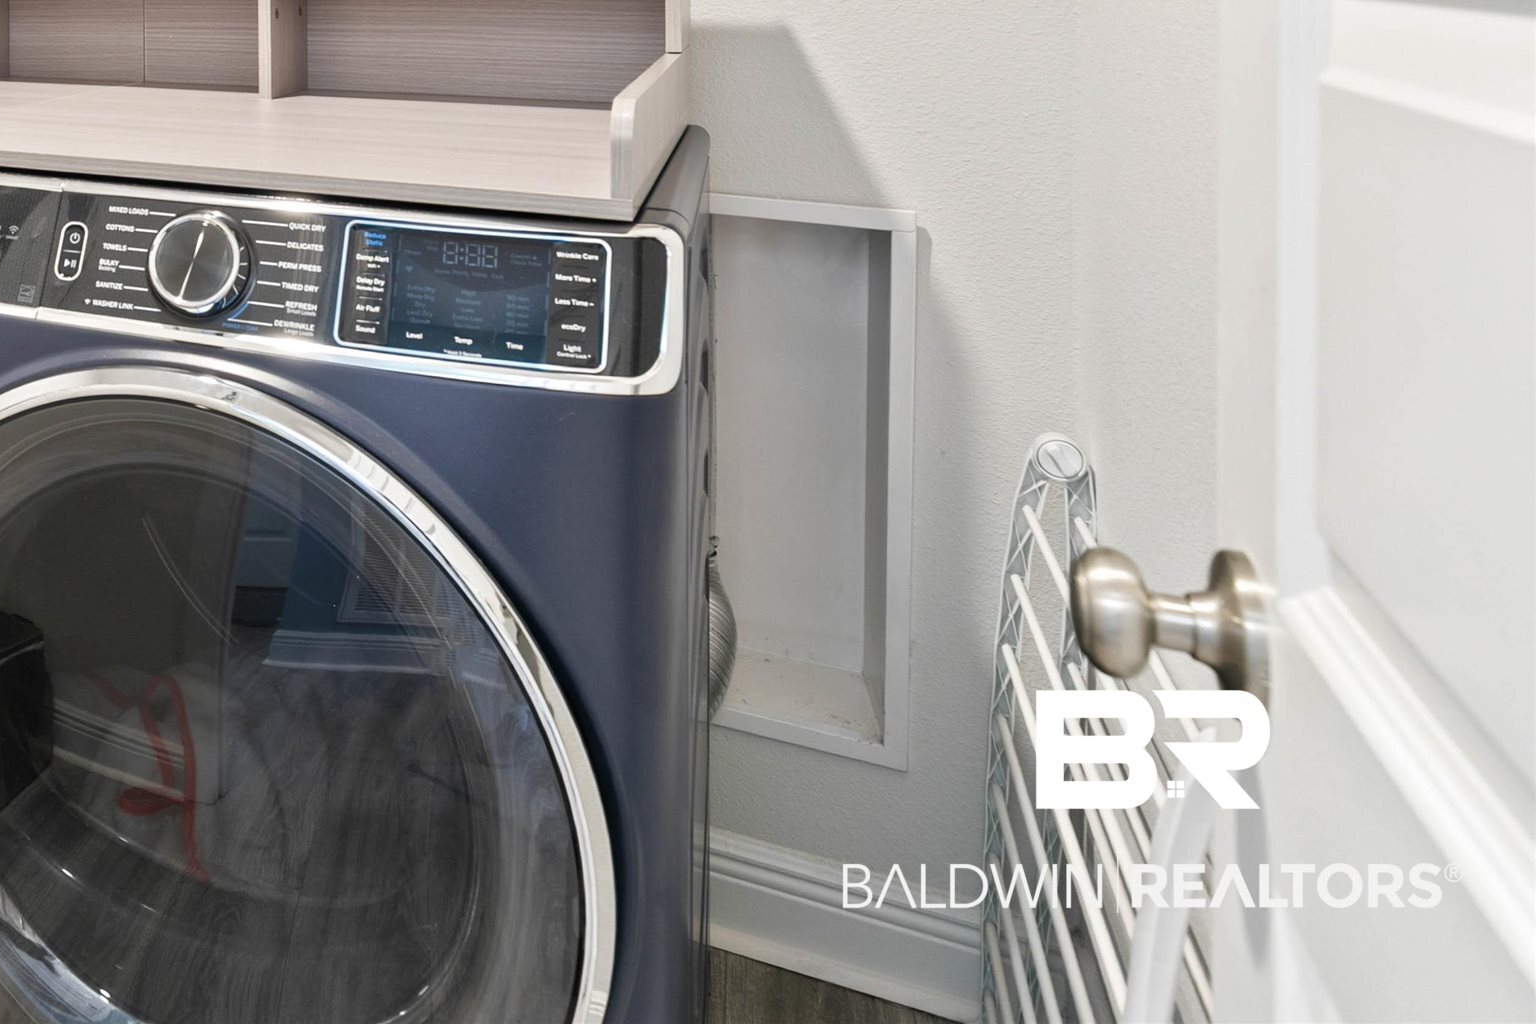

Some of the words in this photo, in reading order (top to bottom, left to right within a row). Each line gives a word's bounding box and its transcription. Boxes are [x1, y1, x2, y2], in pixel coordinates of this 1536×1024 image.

[108, 205, 128, 214] MIXED
[128, 208, 149, 216] LOADS
[105, 223, 135, 232] COTTONS
[289, 222, 310, 231] QUICK
[102, 242, 127, 252] TOWELS
[286, 241, 324, 252] DELICATES
[556, 251, 582, 260] Wrinkle
[582, 253, 599, 261] Care
[98, 258, 120, 267] BULKY
[278, 261, 298, 270] PERM
[298, 263, 322, 273] PRESS
[356, 276, 373, 285] Delay
[373, 278, 385, 286] Dry
[554, 273, 573, 282] More
[573, 274, 591, 283] Time
[95, 280, 124, 290] SANITIZE
[281, 281, 304, 291] TIMED
[304, 284, 320, 293] DRY
[92, 298, 118, 308] WASHER
[118, 302, 134, 311] LINK
[285, 300, 318, 312] REFRESH
[570, 299, 589, 307] Time
[274, 319, 316, 332] DEWRINKLE
[355, 324, 376, 334] Sound
[405, 331, 423, 340] Level
[454, 336, 474, 346] Temp
[505, 341, 524, 351] Time
[563, 344, 582, 353] Light
